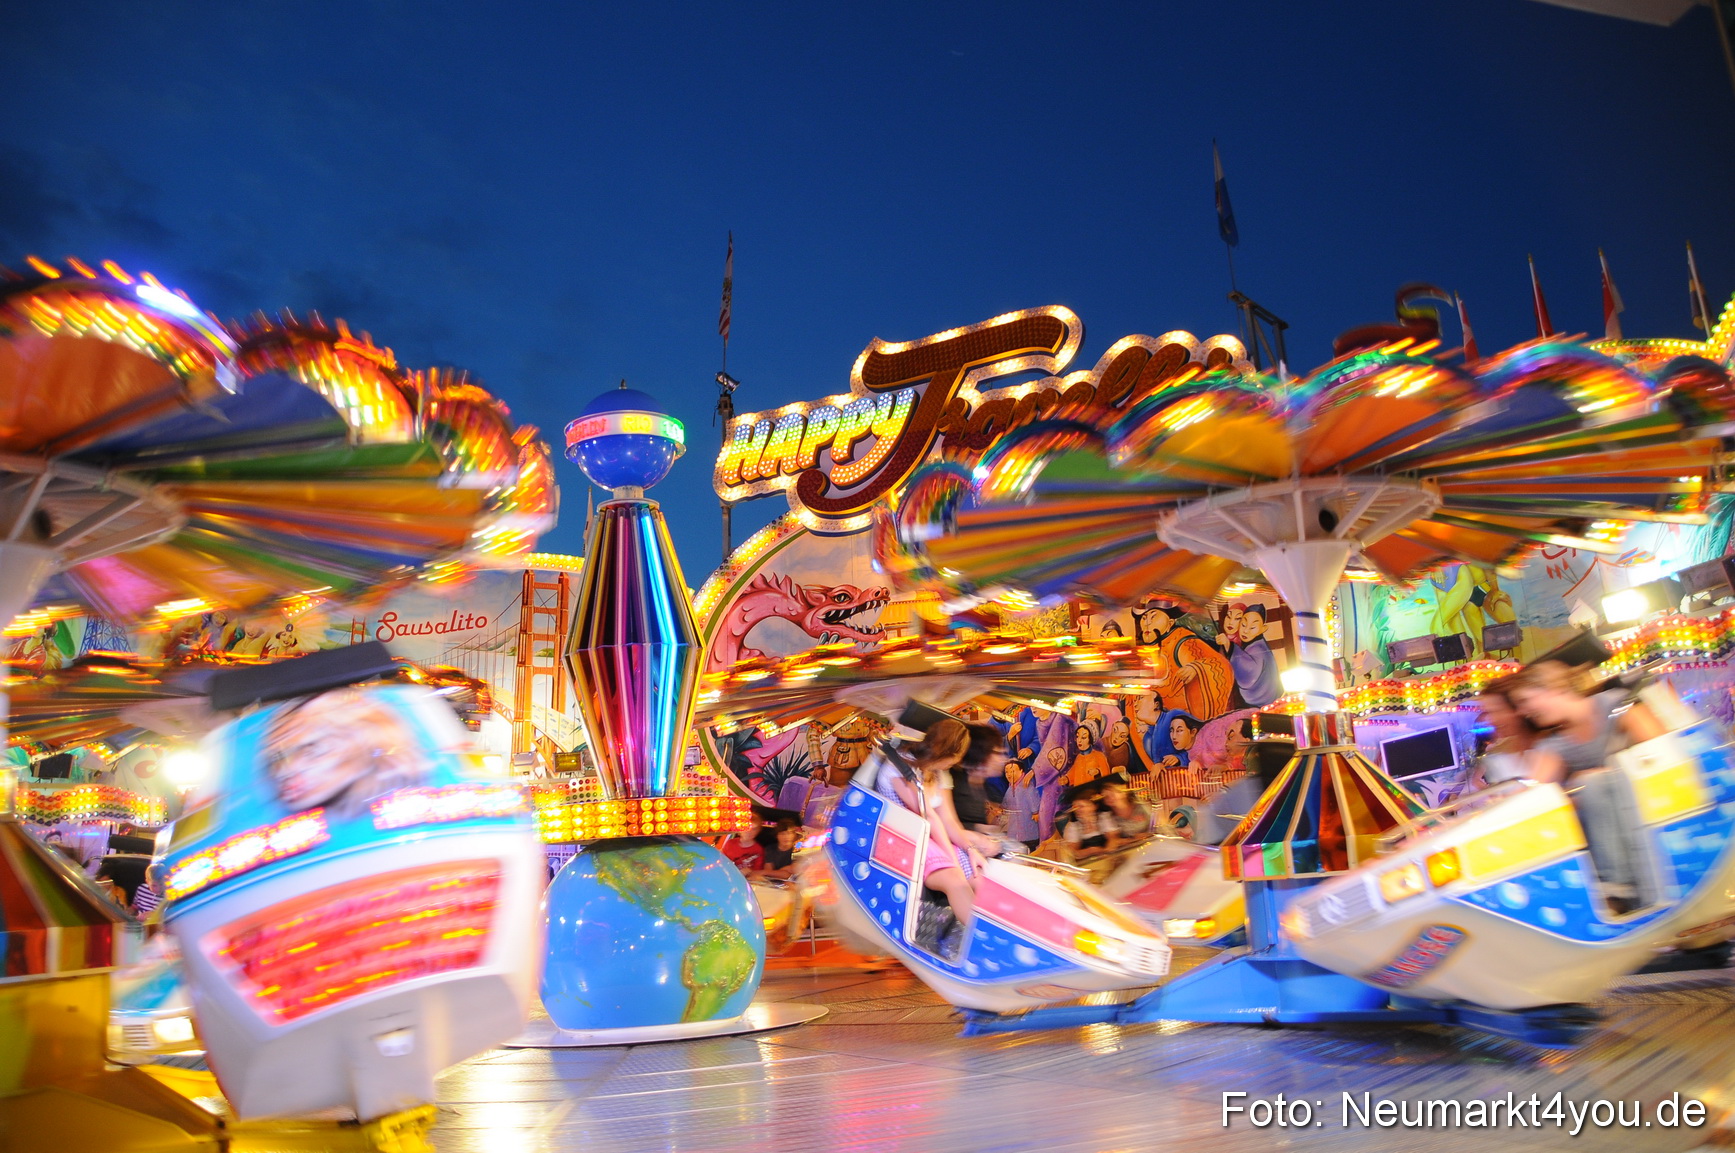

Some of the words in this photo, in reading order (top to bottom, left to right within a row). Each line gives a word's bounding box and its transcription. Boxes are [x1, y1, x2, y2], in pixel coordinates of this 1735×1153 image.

[622, 414, 652, 432] RIO
[722, 387, 917, 487] HAPPY
[375, 610, 488, 643] Sausalito
